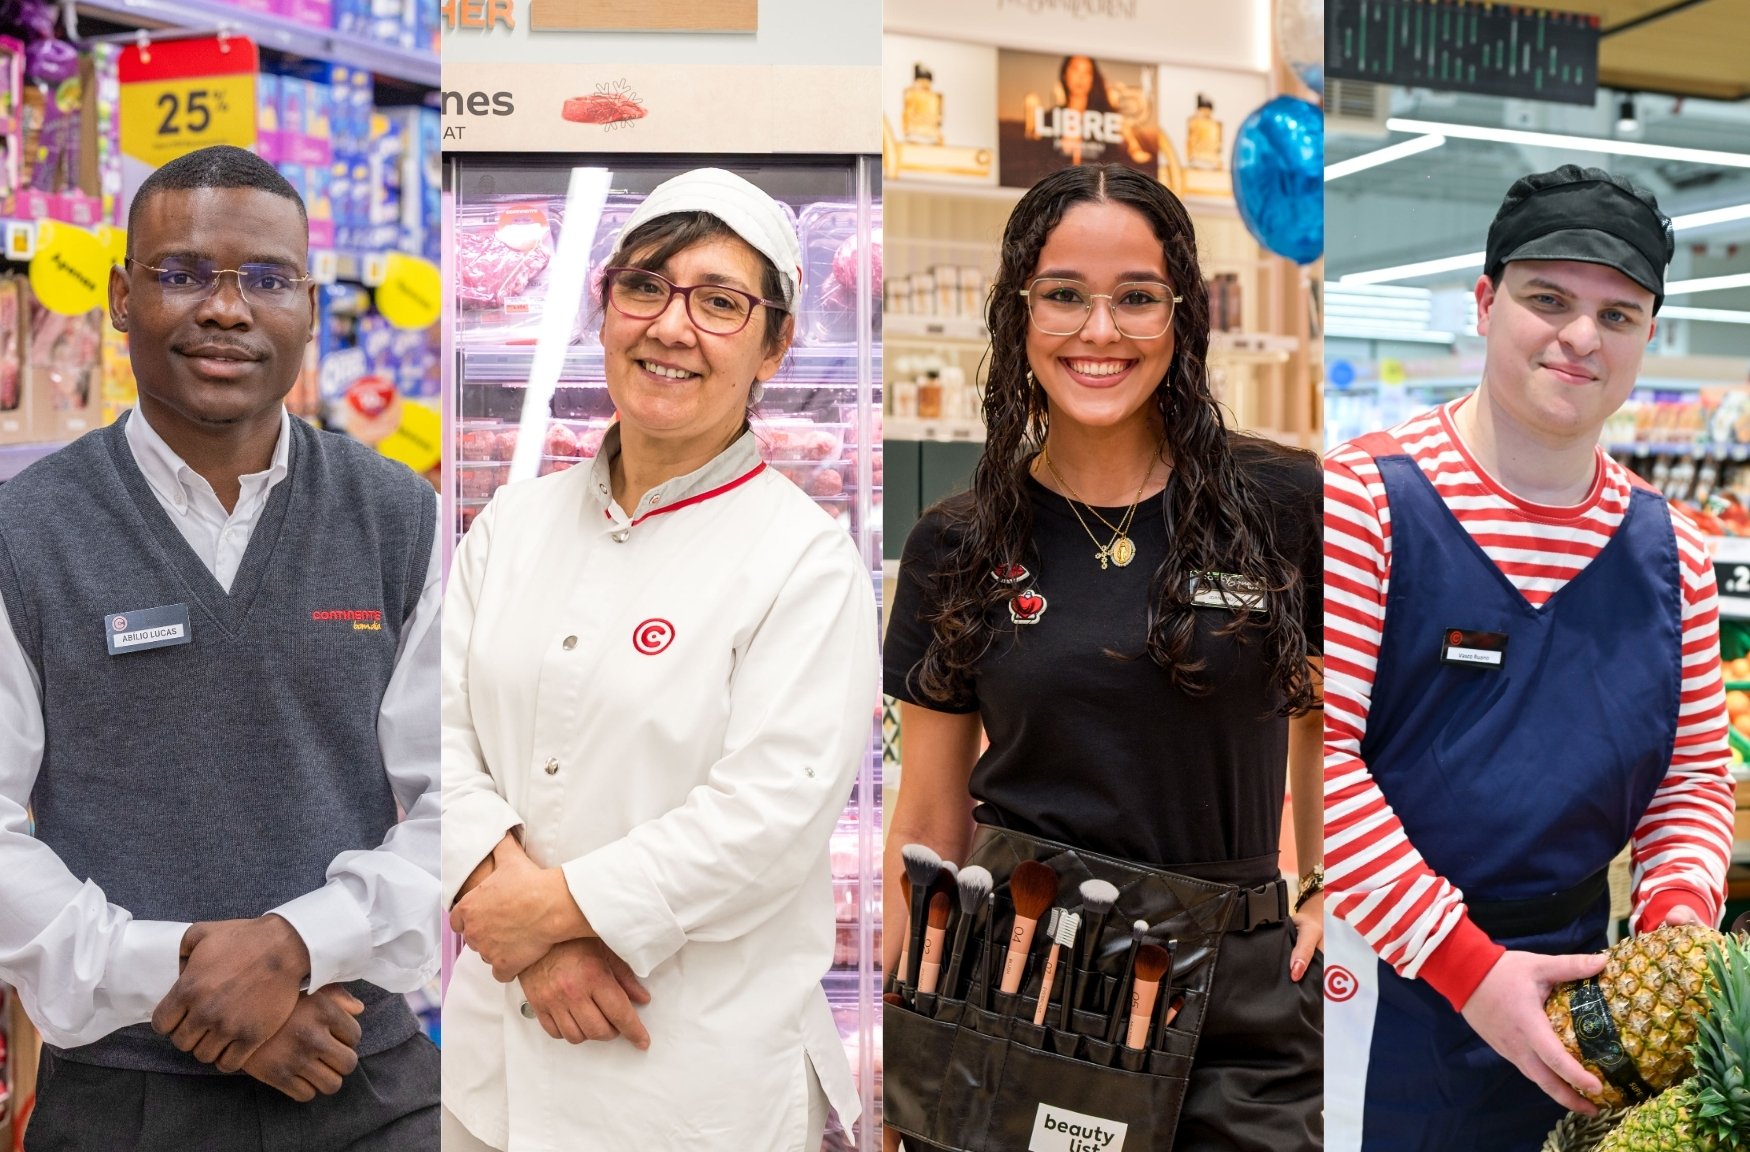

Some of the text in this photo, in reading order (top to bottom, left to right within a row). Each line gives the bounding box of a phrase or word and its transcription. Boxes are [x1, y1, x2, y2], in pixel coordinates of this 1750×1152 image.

[441, 91, 515, 116] nes
[443, 126, 466, 140] AT
[1034, 106, 1124, 144] LIBRE
[122, 627, 177, 643] ABÍLIO LUCAS
[1044, 1113, 1115, 1147] beauty
[1069, 1138, 1101, 1152] list
